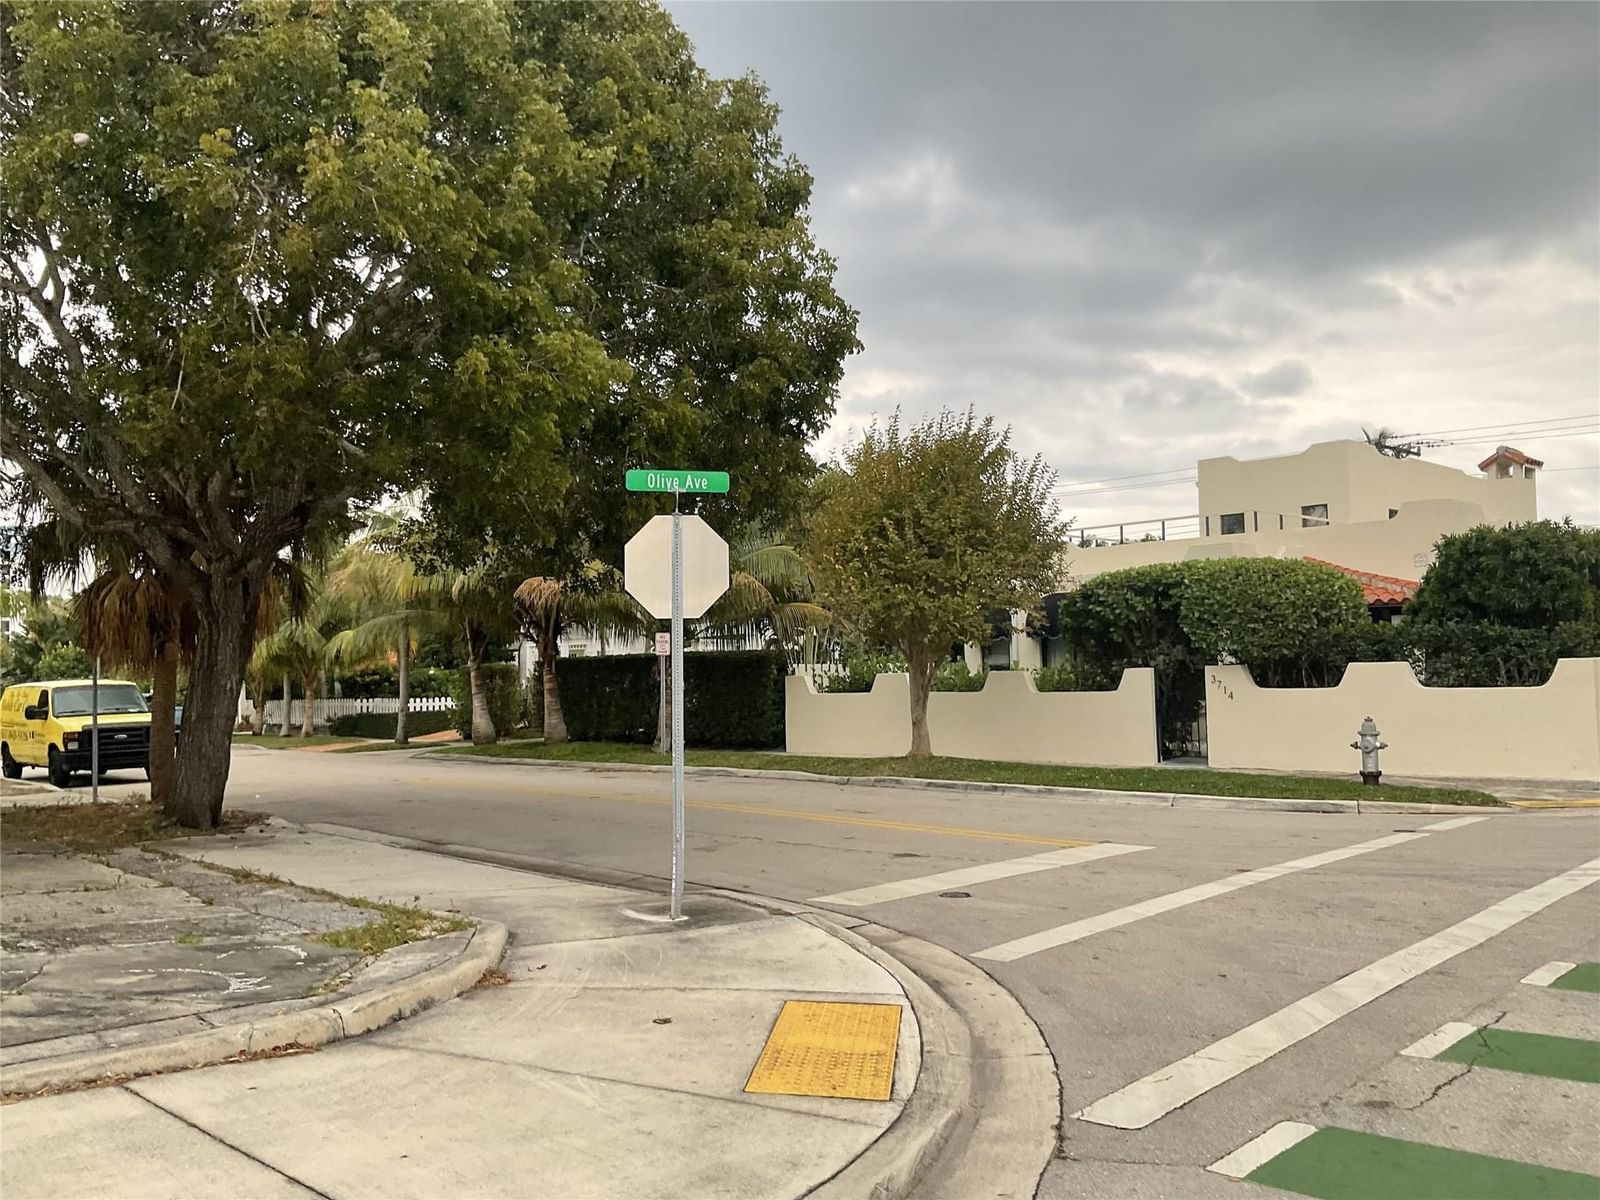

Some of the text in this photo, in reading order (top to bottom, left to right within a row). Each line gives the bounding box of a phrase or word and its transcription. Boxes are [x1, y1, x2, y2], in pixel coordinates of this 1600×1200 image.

[647, 473, 708, 489] Olive Ave
[1210, 674, 1234, 700] 3714
